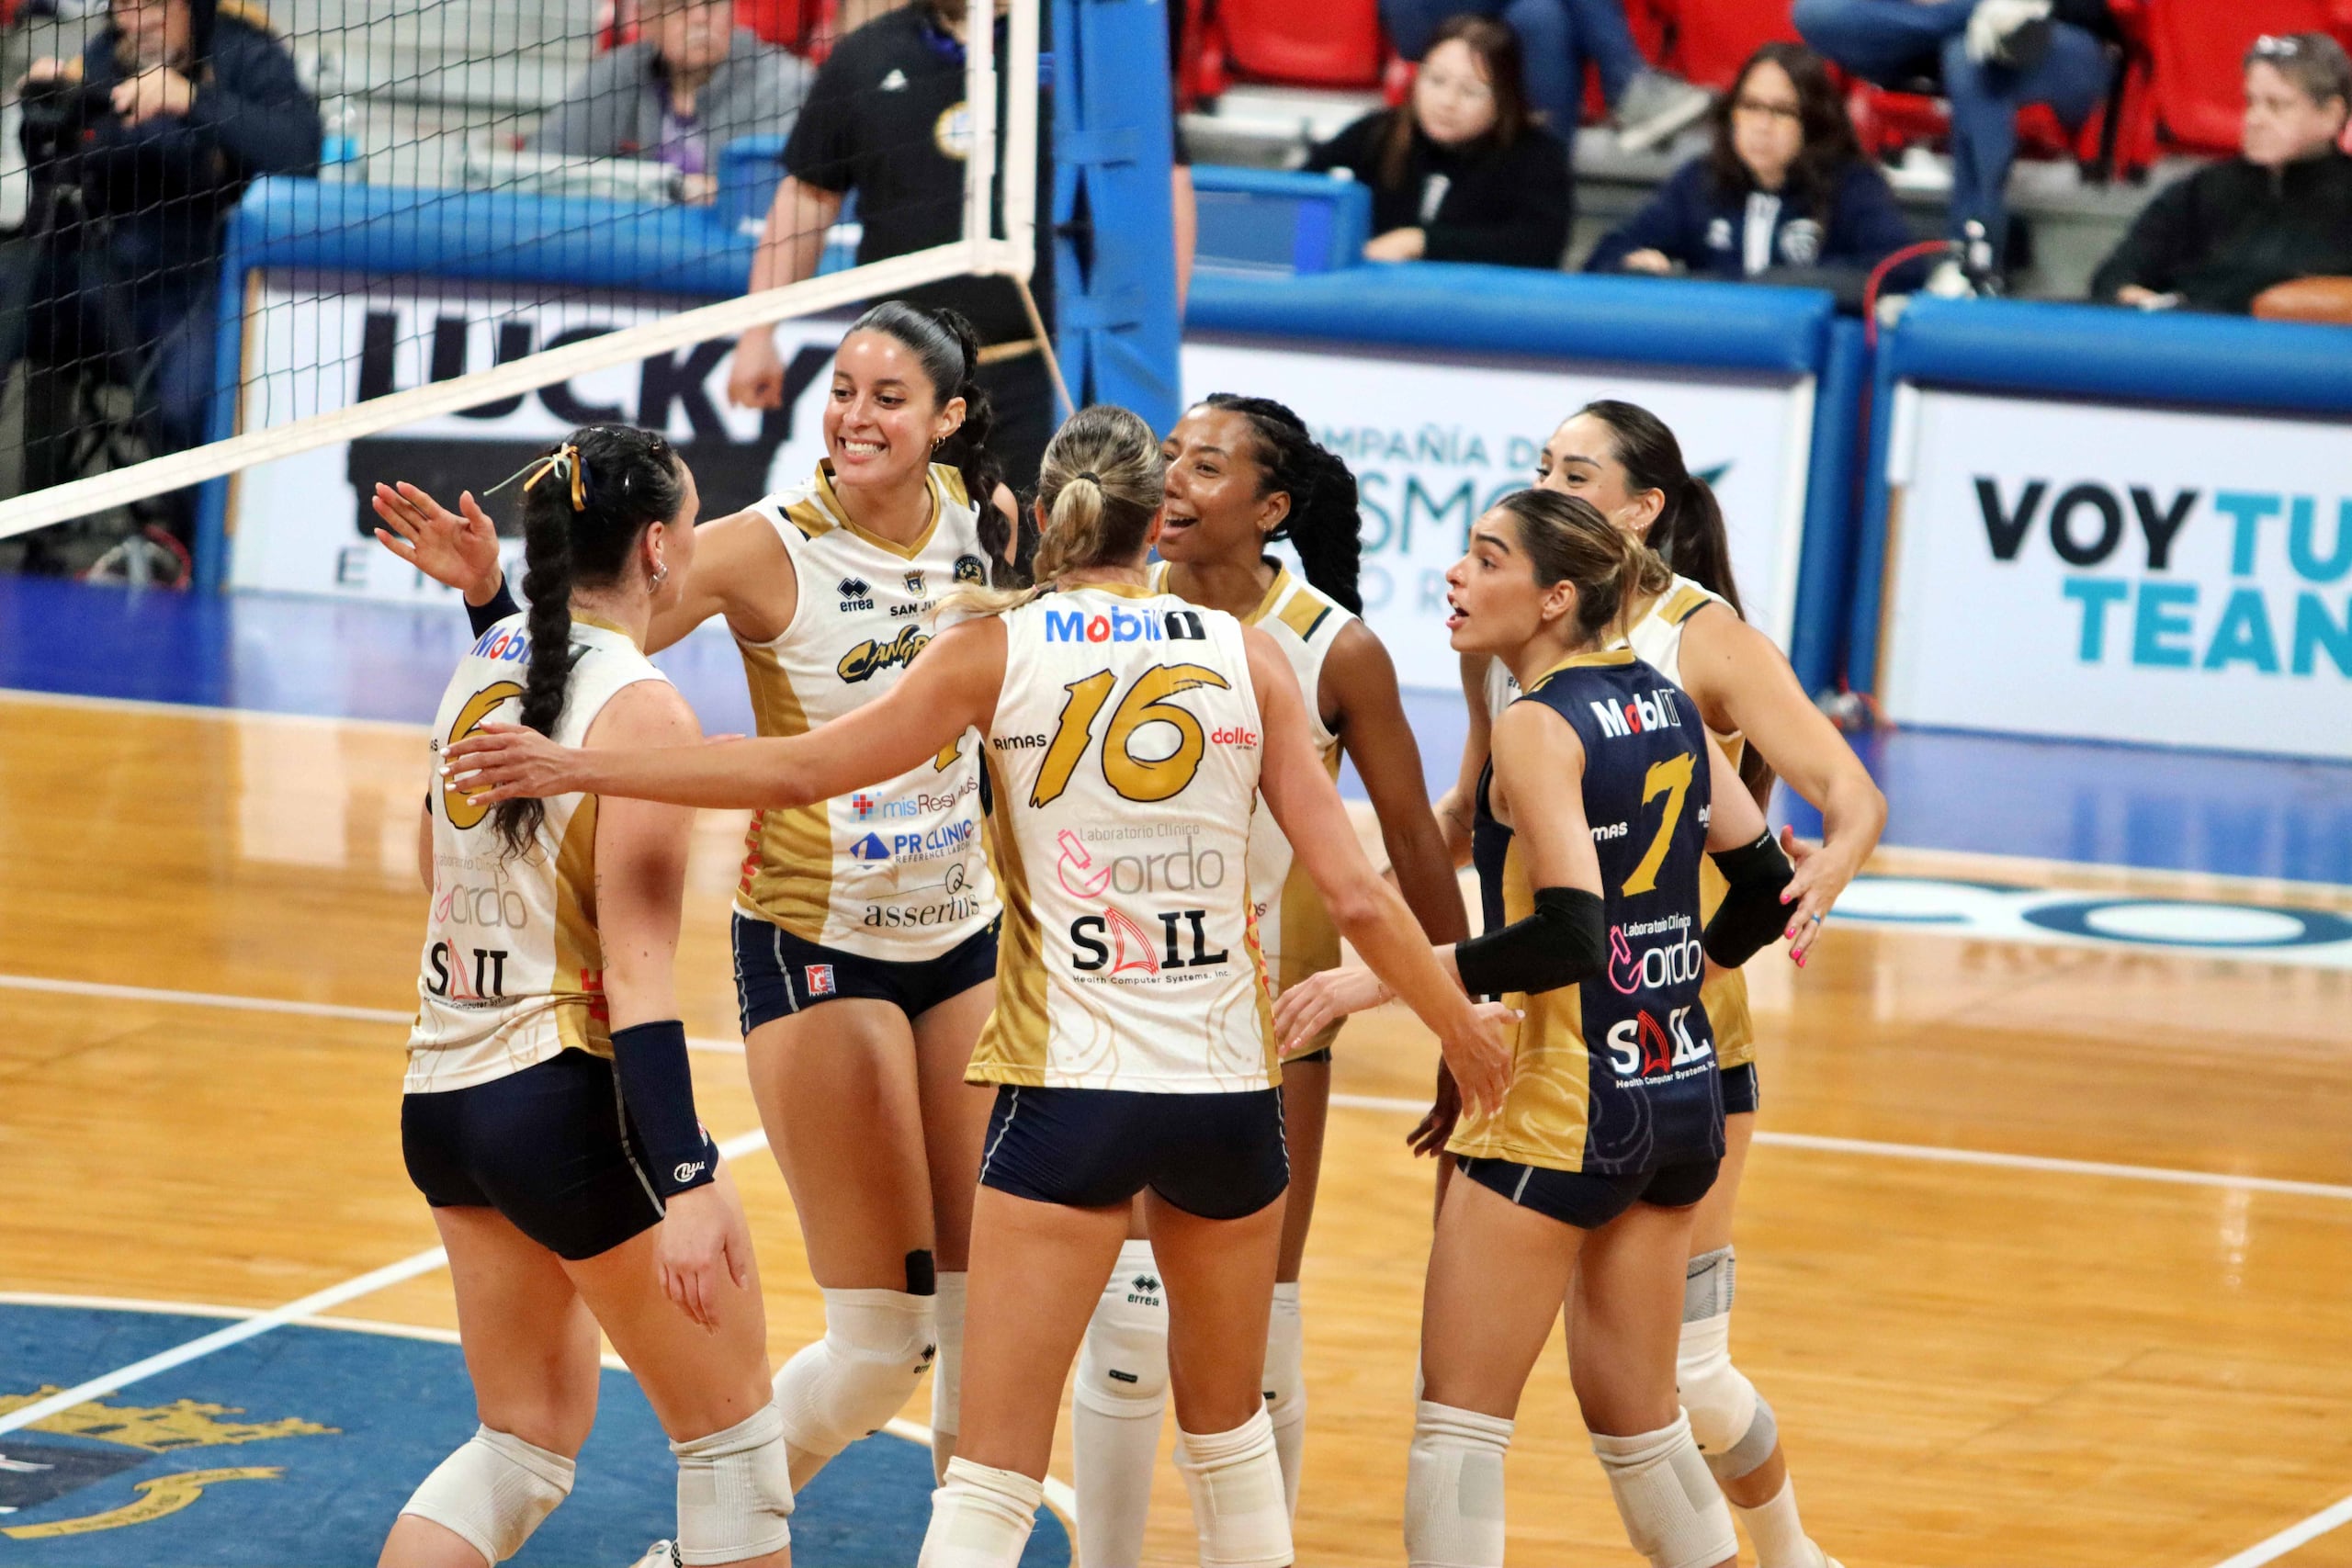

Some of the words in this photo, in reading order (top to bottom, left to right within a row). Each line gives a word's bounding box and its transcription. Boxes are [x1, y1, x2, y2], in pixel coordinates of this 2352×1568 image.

[1973, 474, 2202, 571] VOY
[840, 598, 874, 612] errea
[890, 603, 917, 616] SAN
[1046, 605, 1162, 642] Mobil
[1029, 663, 1232, 808] 16
[1080, 826, 1153, 841] Laboratorio
[1591, 821, 1628, 840] MAS
[1622, 751, 1697, 897] 7
[894, 833, 922, 854] PR
[864, 893, 979, 928] assertus
[1073, 976, 1106, 984] Health
[1111, 976, 1160, 985] Computer
[1616, 1077, 1644, 1089] Health
[1127, 1293, 1159, 1306] errea
